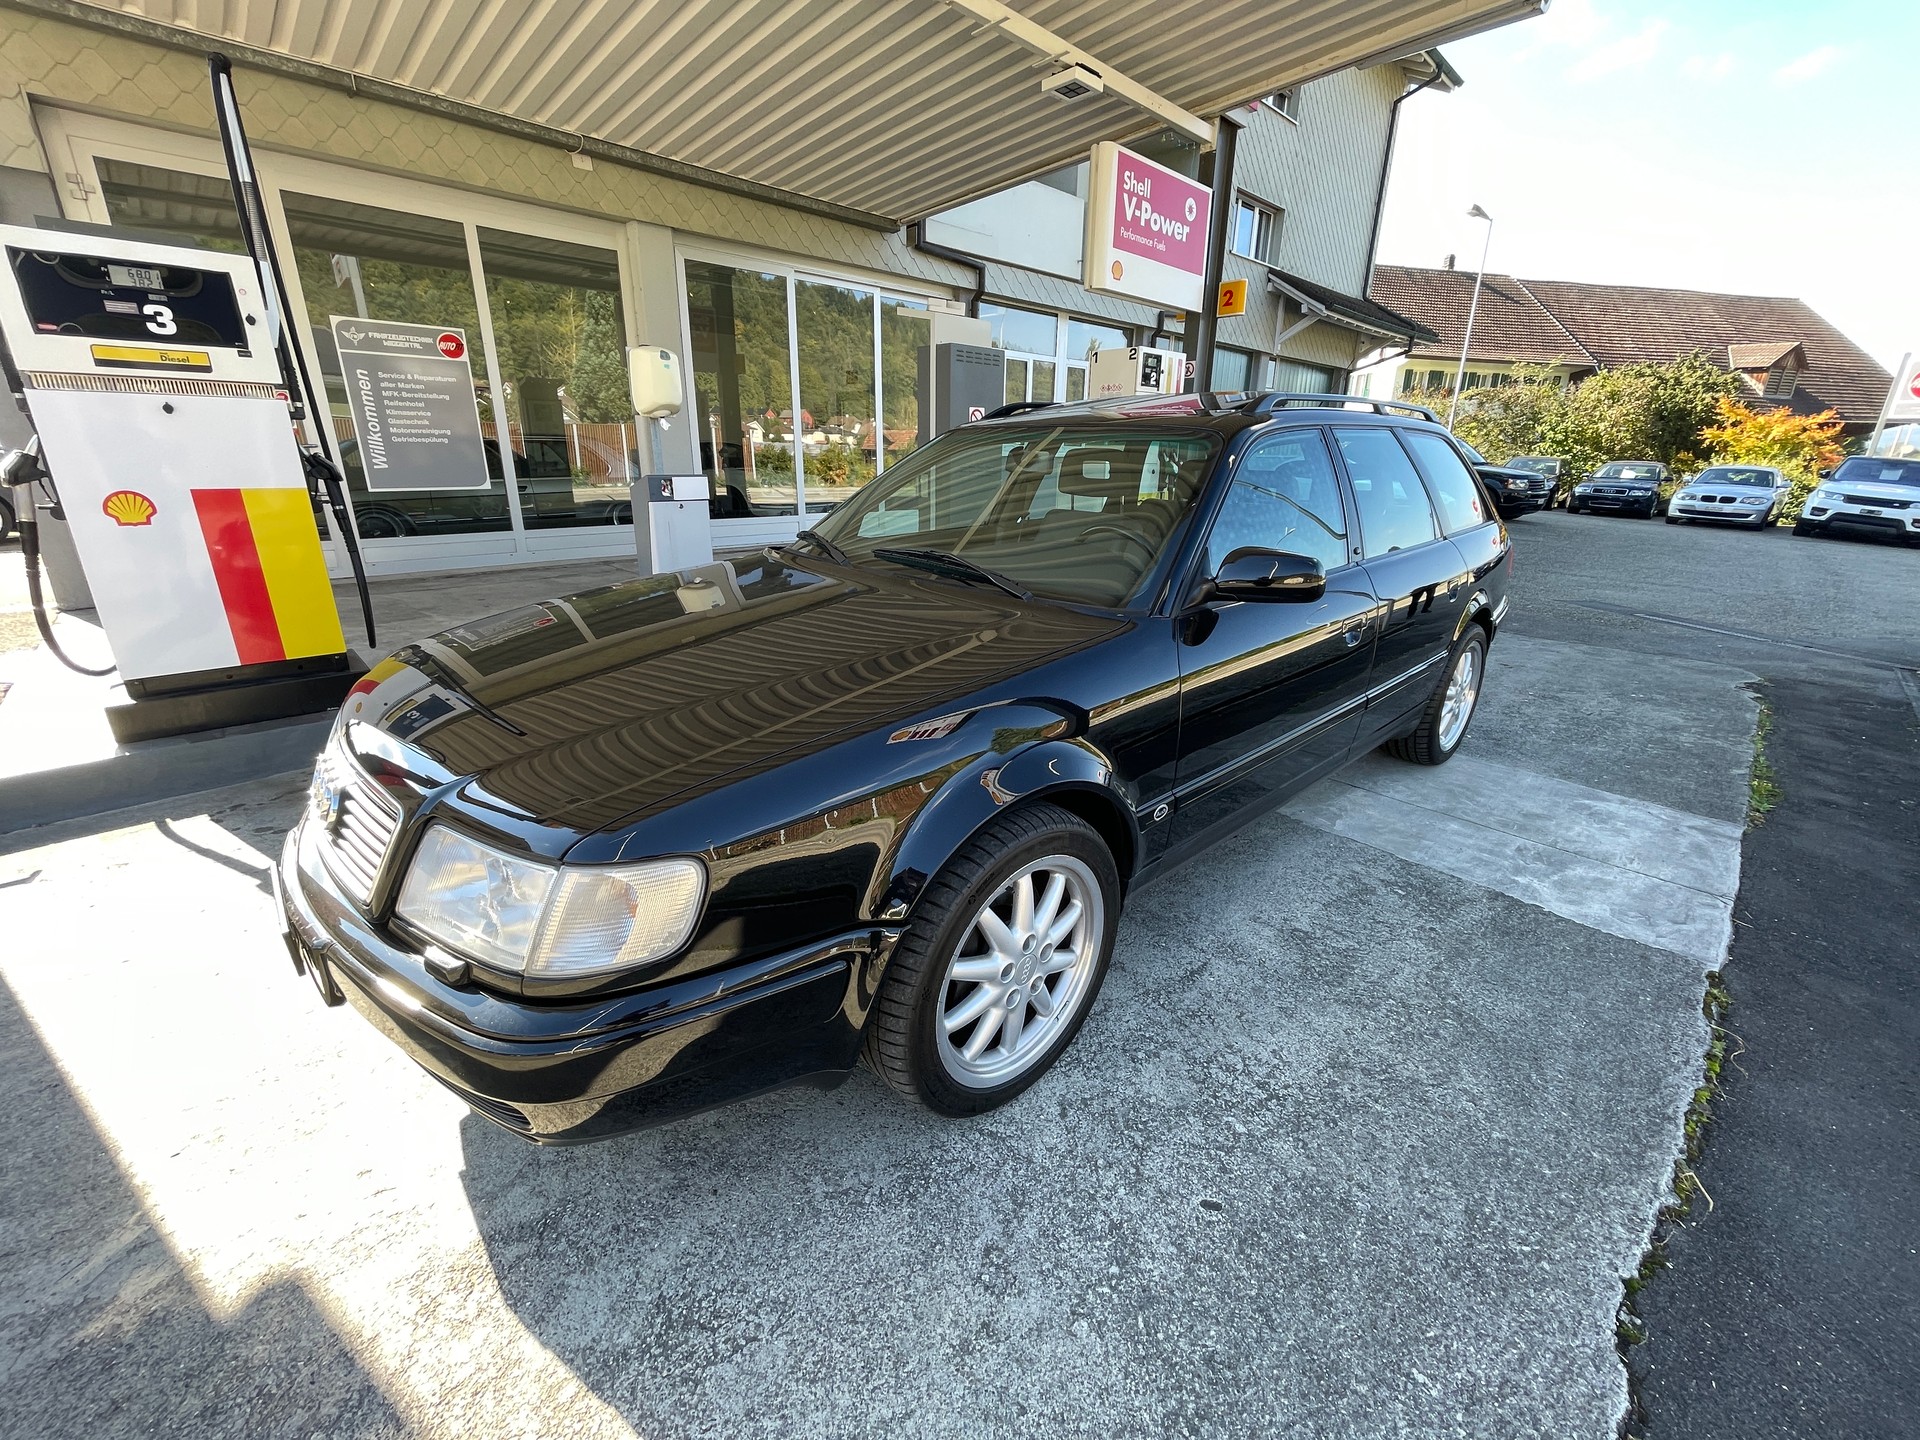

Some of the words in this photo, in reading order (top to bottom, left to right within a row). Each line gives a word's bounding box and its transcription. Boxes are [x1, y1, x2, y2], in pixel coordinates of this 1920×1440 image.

[1123, 170, 1151, 199] Shell
[1122, 193, 1190, 243] V-Power
[1120, 226, 1153, 247] Performance
[1153, 239, 1166, 252] Fuels
[1222, 289, 1234, 307] 2
[142, 303, 178, 336] 3
[160, 354, 190, 364] Diesel
[1092, 351, 1098, 364] 1
[1128, 347, 1137, 361] 2
[378, 371, 406, 380] Service
[413, 373, 457, 383] Reparaturen
[1150, 371, 1157, 385] 2
[397, 382, 425, 390] Marken
[381, 390, 450, 401] MFK-Bereitstellung
[384, 399, 425, 408] Reifenhotel
[385, 408, 432, 417] Klimaservice
[356, 369, 389, 469] Willkommen
[387, 417, 430, 425] Glastechnik
[389, 427, 451, 435] Motorenreinigung
[391, 436, 449, 444] Getriebespülung
